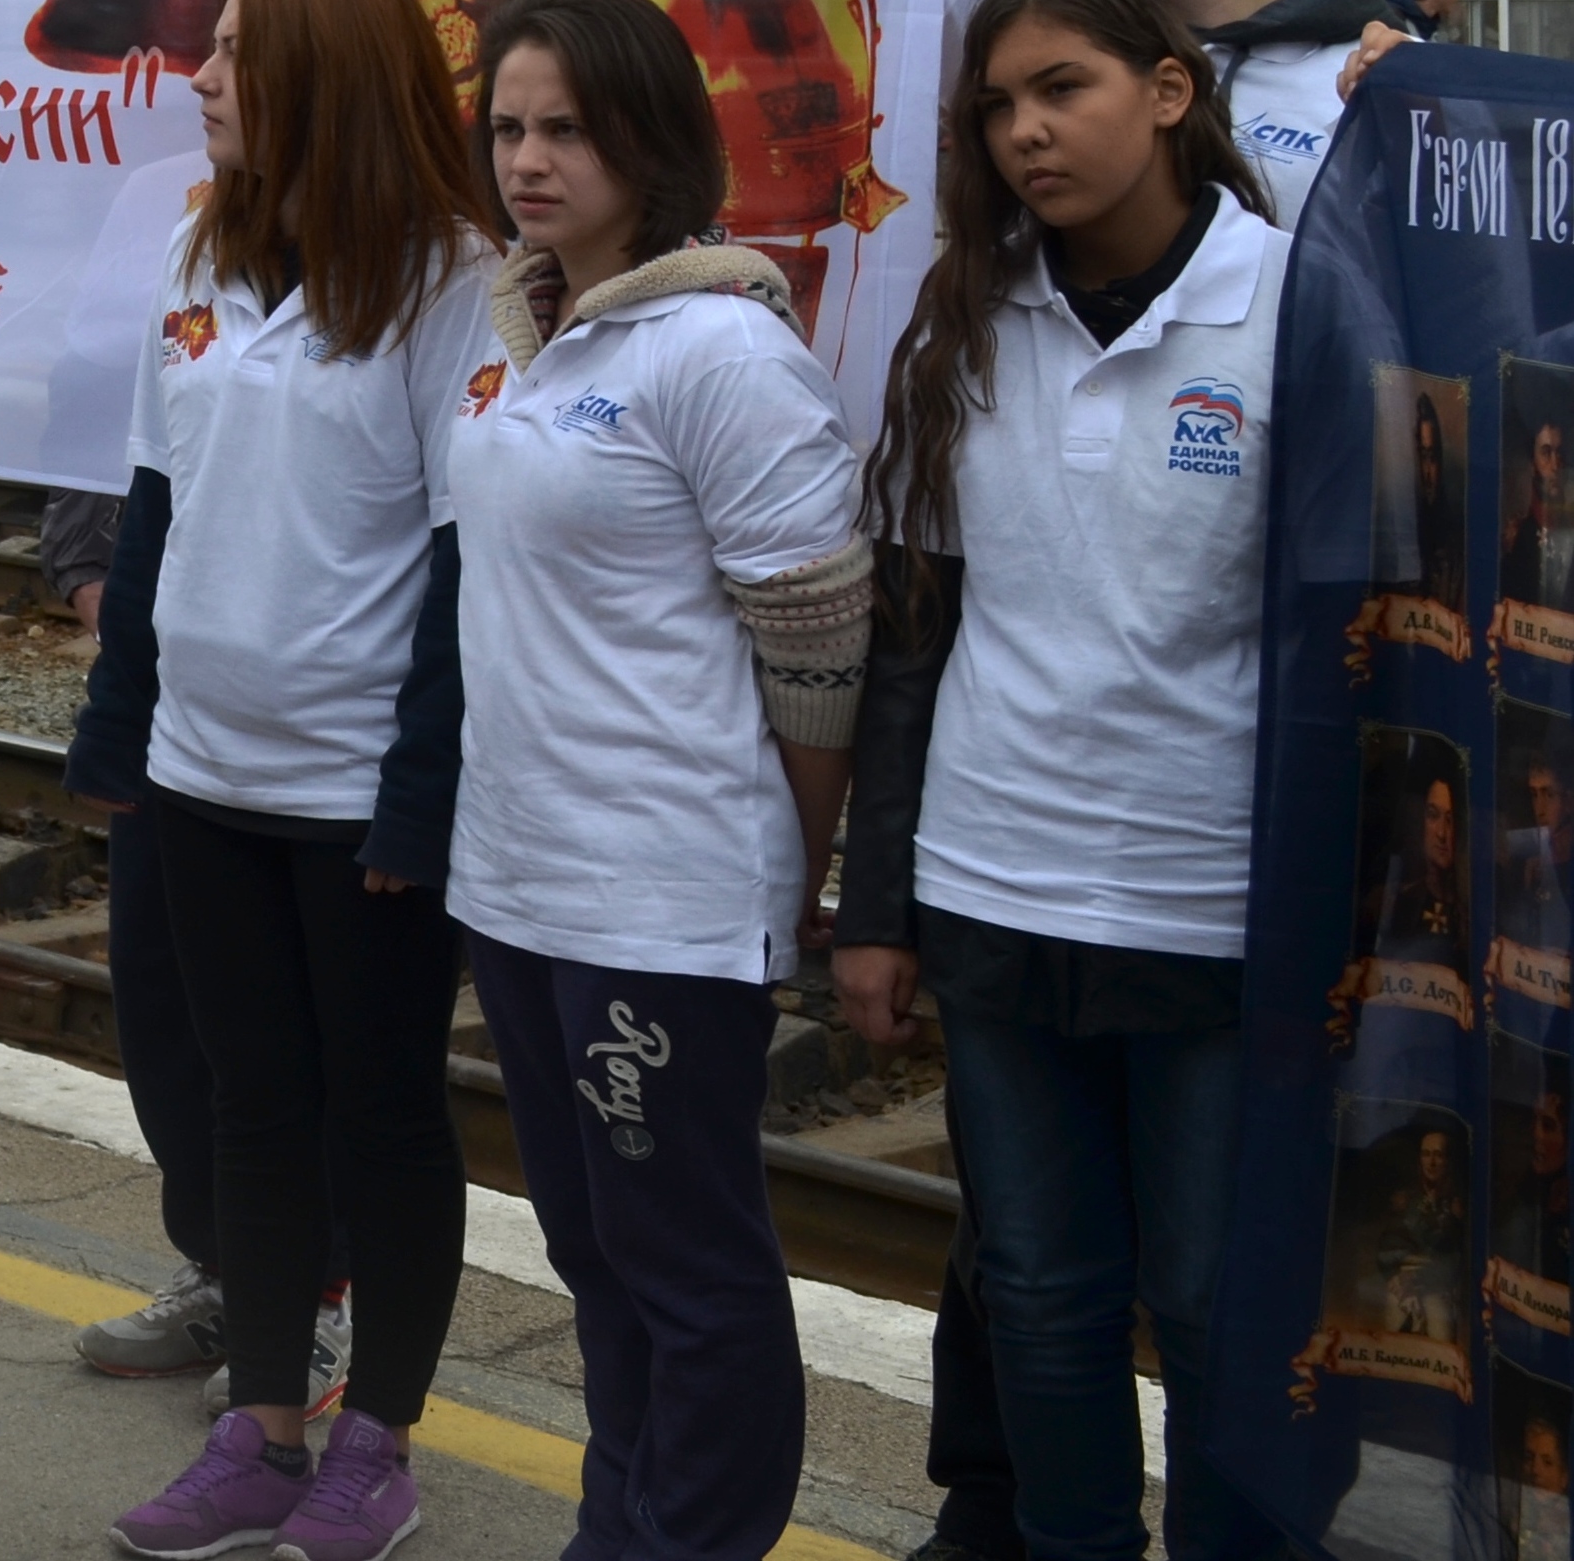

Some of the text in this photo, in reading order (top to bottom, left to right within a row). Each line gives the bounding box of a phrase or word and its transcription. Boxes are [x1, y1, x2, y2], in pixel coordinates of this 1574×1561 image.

[1252, 124, 1325, 152] СПК
[1407, 109, 1574, 245] Герои 18
[577, 395, 628, 424] СПК
[1168, 458, 1241, 477] РОССИЯ
[1169, 445, 1240, 462] ЕДИНАЯ
[576, 1000, 671, 1122] Roxy
